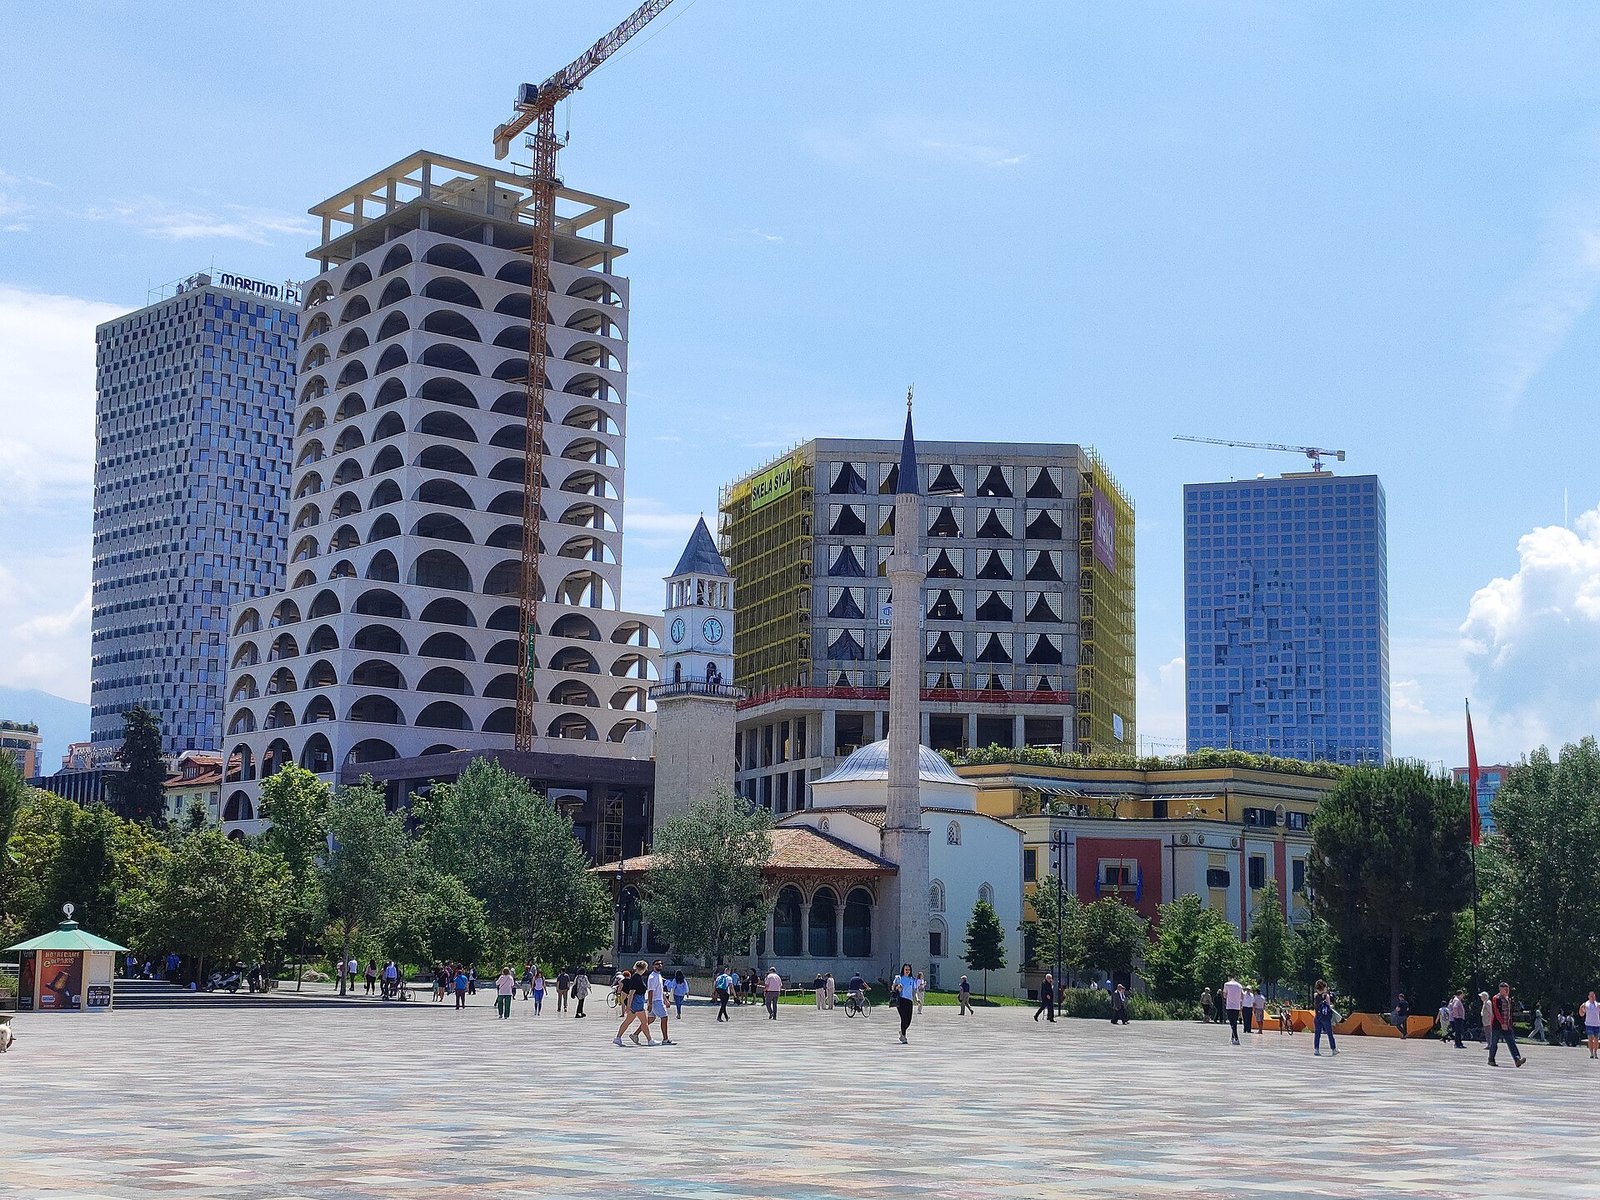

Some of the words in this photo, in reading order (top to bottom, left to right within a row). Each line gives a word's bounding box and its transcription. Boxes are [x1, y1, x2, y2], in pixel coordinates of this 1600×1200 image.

[221, 274, 278, 297] MARITIM
[752, 479, 773, 501] SKELA
[774, 469, 790, 490] SYLA
